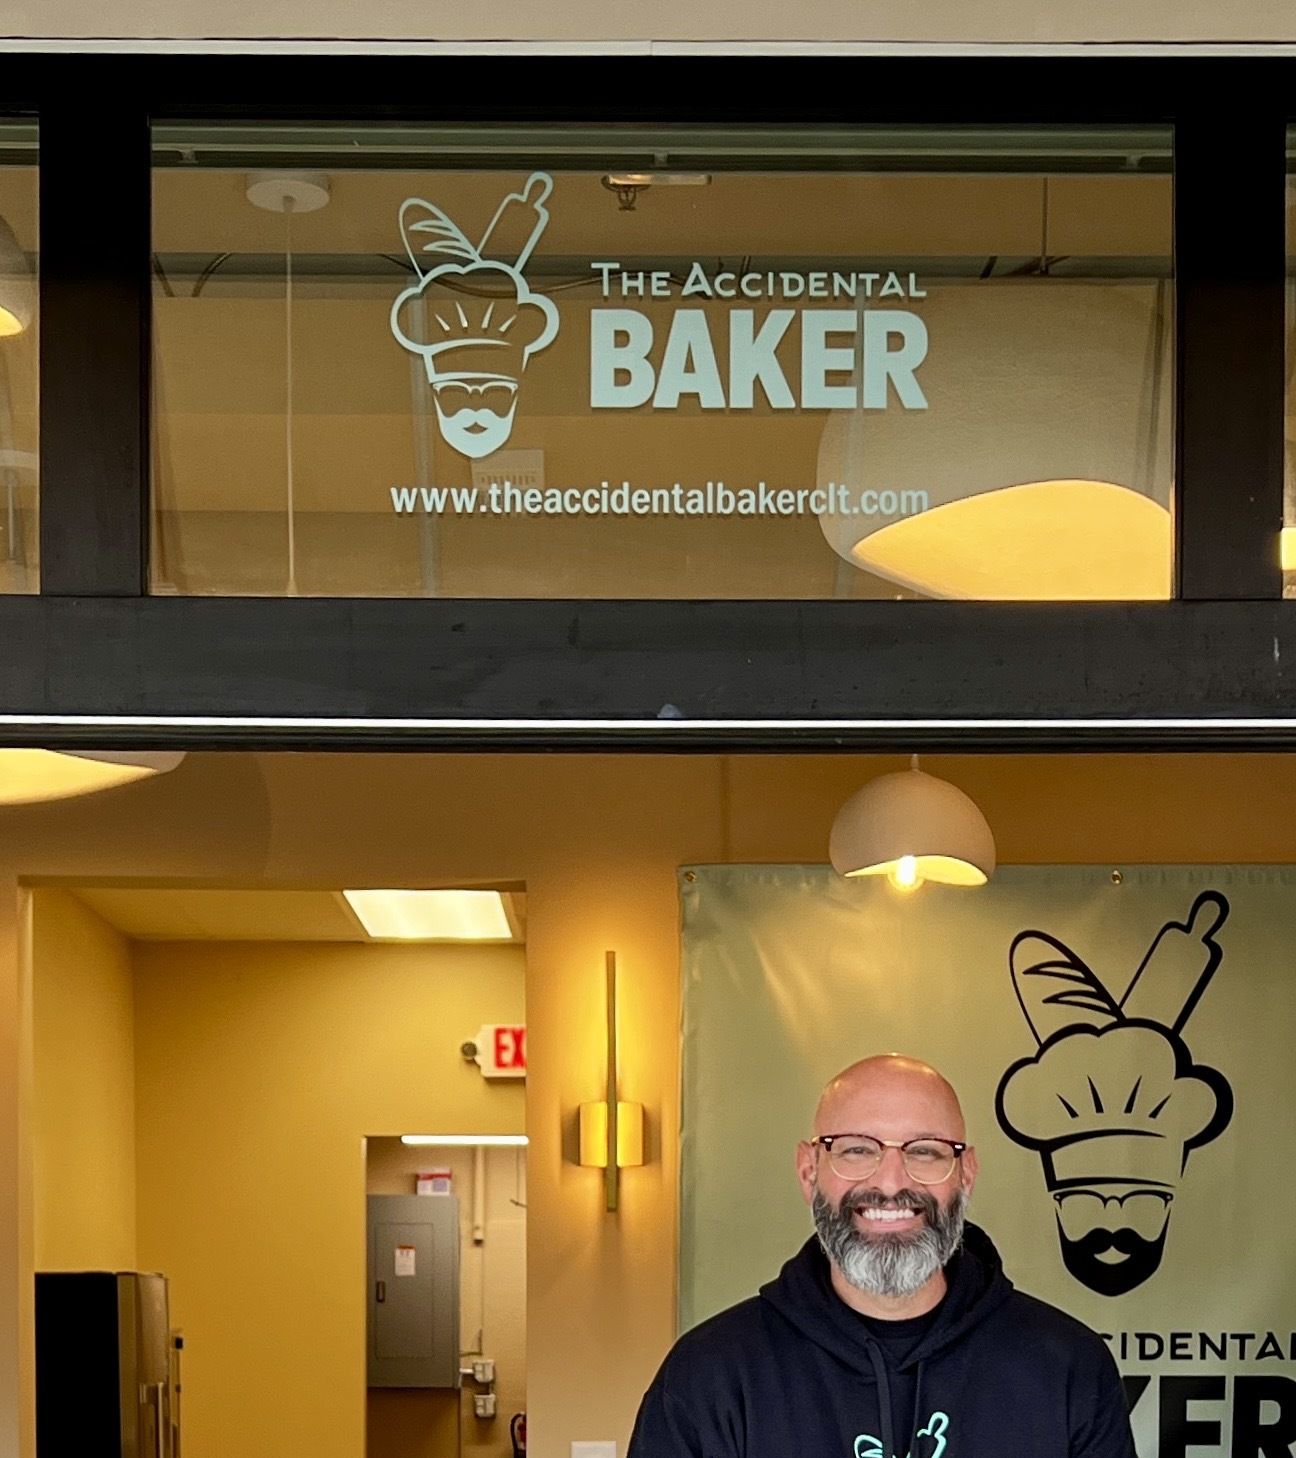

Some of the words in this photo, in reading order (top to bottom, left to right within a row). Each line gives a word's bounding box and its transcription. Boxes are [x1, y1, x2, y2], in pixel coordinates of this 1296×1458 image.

[591, 262, 671, 298] THE
[681, 262, 927, 298] ACCIDENTAL
[590, 308, 929, 410] BAKER
[390, 480, 929, 516] www.theaccidentalbakerclt.com
[494, 1027, 527, 1069] EX
